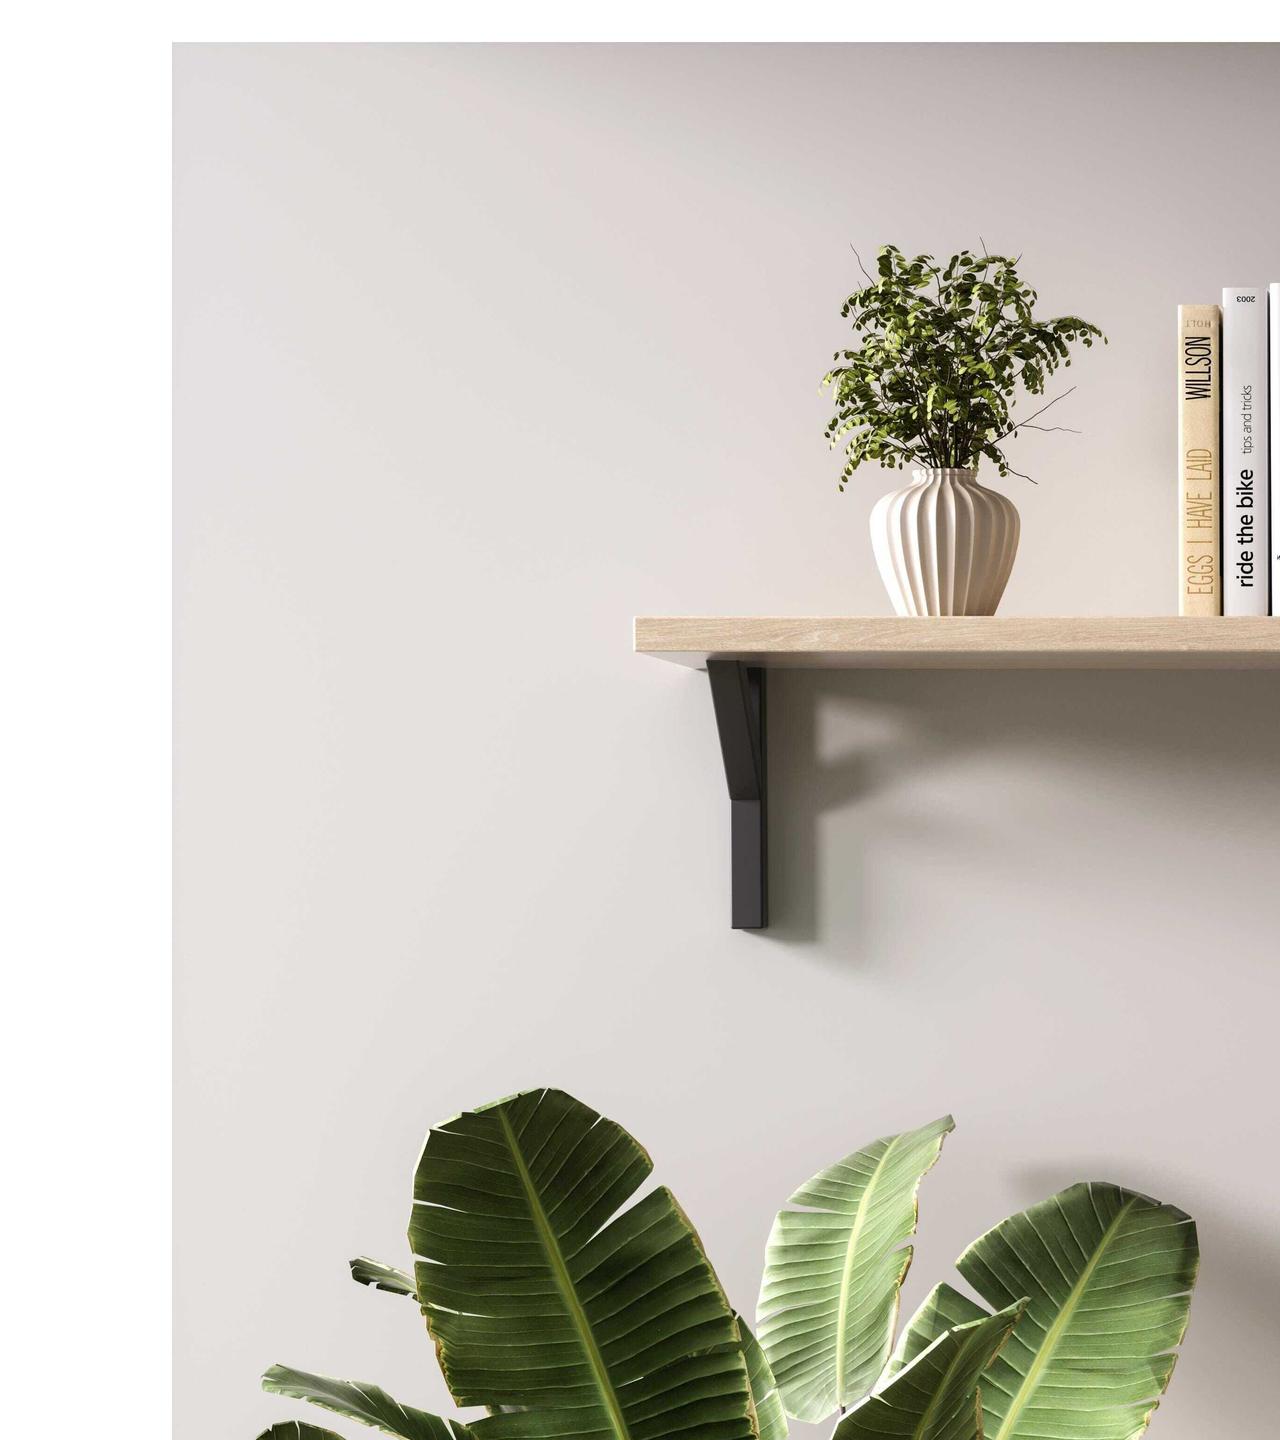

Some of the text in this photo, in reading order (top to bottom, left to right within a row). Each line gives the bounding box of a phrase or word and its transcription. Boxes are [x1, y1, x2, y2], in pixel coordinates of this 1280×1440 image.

[1236, 295, 1256, 303] 2003
[1184, 336, 1212, 401] WILLSON
[1187, 448, 1213, 481] LAID
[1235, 384, 1254, 587] ride the bike tips and tricks
[1187, 491, 1213, 529] HAVE
[1187, 553, 1214, 596] EGGS
